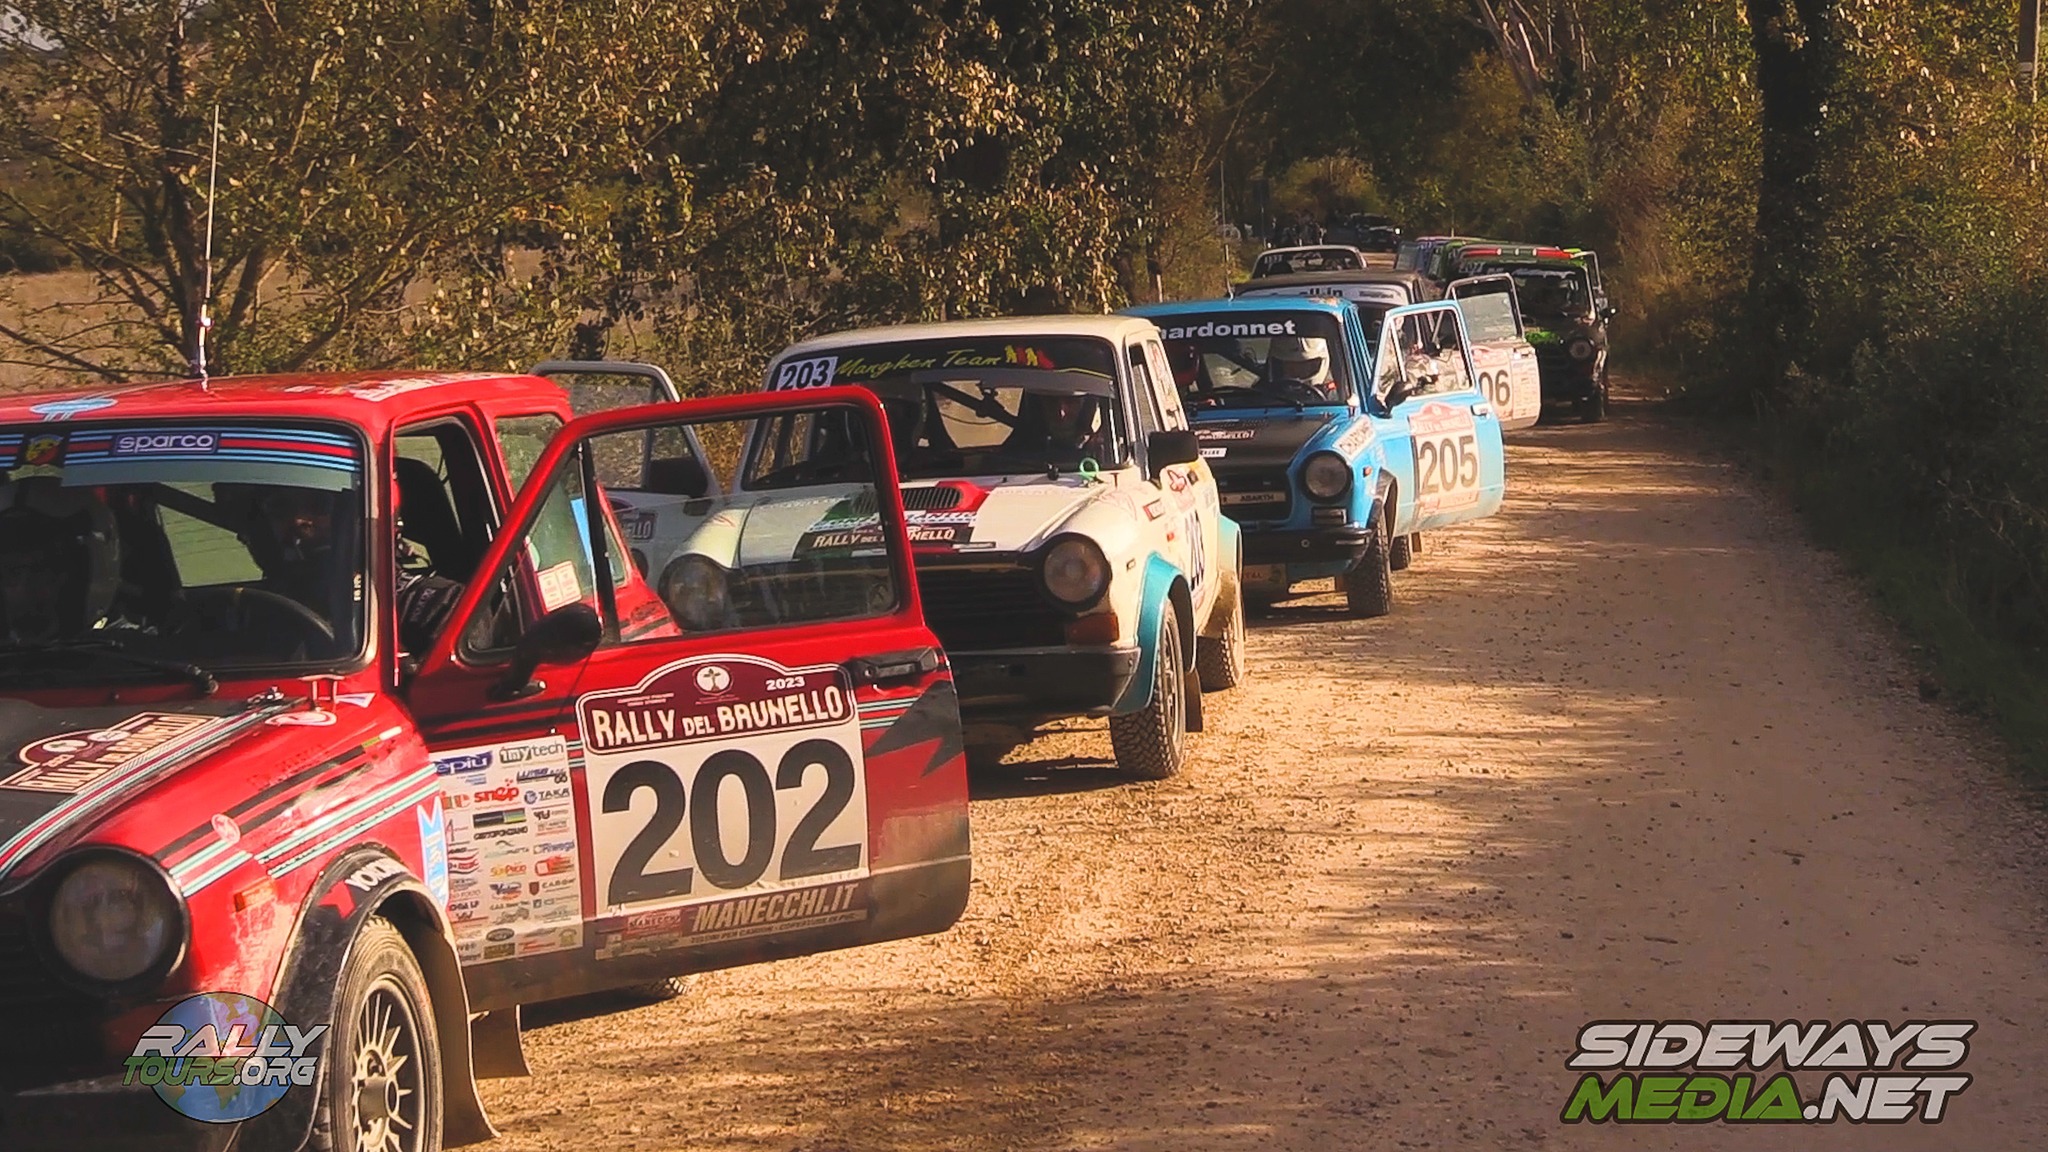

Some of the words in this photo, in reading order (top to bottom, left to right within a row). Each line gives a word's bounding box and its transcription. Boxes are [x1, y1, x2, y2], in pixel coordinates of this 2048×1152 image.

[783, 360, 830, 390] 203
[942, 349, 1002, 368] Team
[1479, 369, 1511, 407] 06
[118, 434, 214, 453] sparco
[1418, 435, 1478, 495] 205
[812, 533, 862, 548] RALLY
[765, 676, 806, 691] 2023
[591, 708, 676, 748] RALLY
[681, 716, 716, 737] DEL
[716, 686, 844, 733] BRUNELLO
[602, 738, 863, 907] 202
[691, 883, 860, 933] MANECCHI.IT
